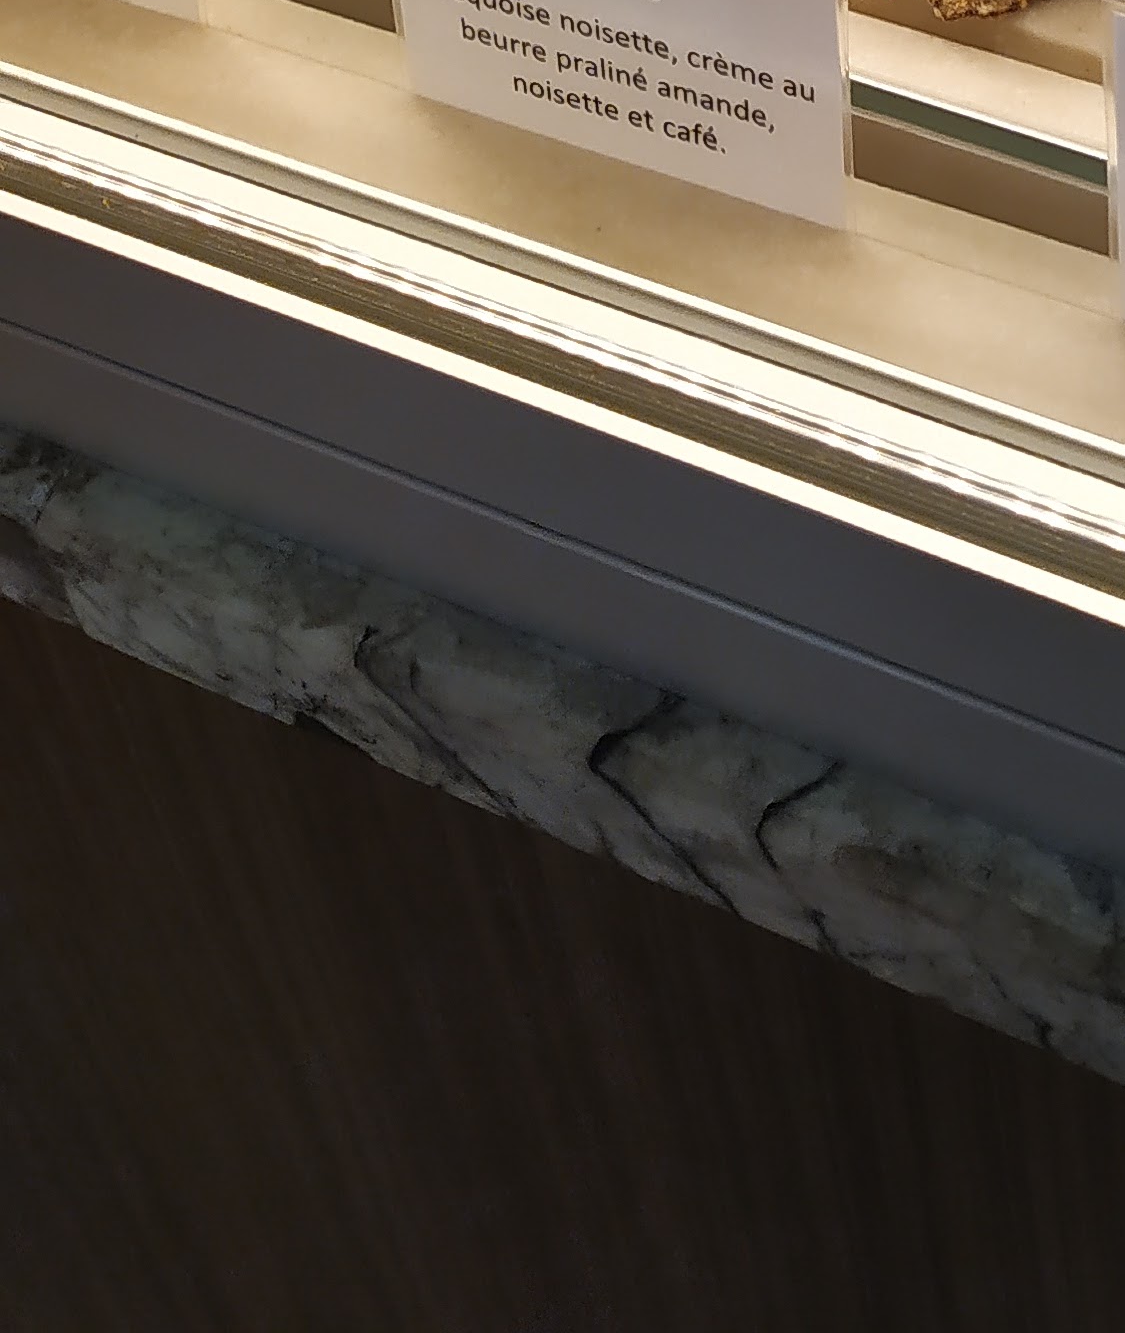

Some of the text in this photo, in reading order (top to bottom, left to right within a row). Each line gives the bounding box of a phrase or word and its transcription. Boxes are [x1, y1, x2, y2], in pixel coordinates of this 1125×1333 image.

[461, 17, 775, 133] beurre praliné amande,
[560, 12, 678, 66] noisette,
[687, 50, 774, 91] crème
[782, 75, 816, 102] au
[513, 73, 726, 154] noisette et café.
